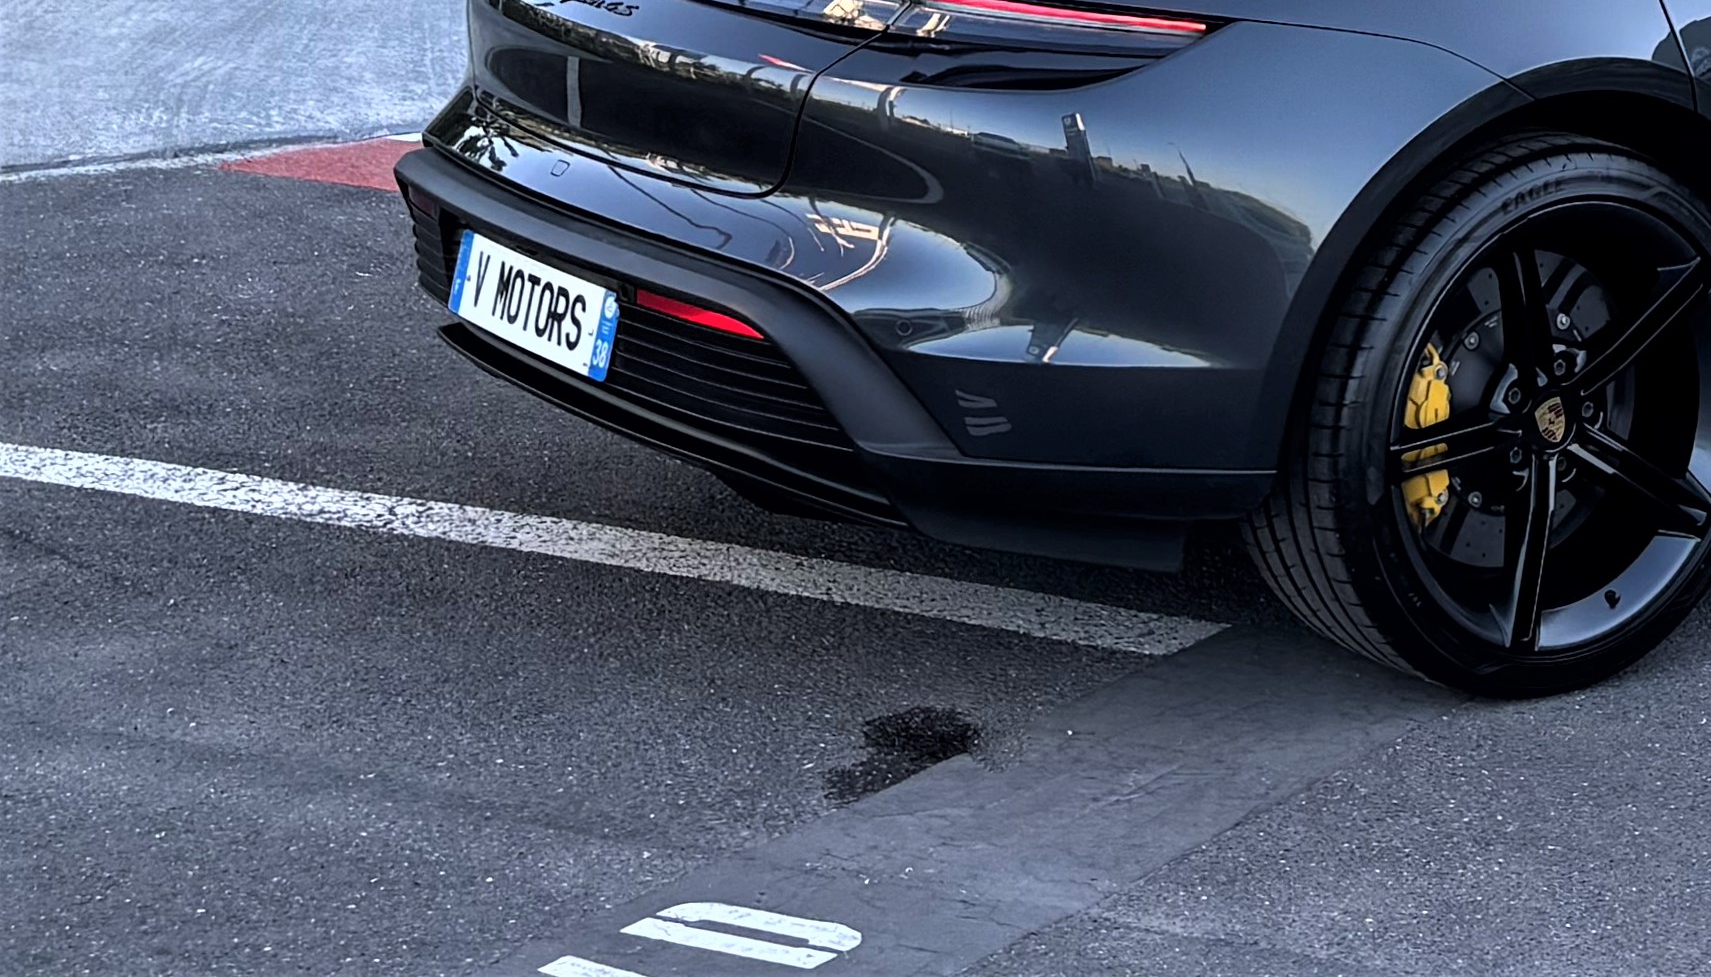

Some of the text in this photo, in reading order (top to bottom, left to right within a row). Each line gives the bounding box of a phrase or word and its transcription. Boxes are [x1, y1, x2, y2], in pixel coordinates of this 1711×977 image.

[473, 250, 587, 352] V MOTORS
[592, 338, 610, 369] 38
